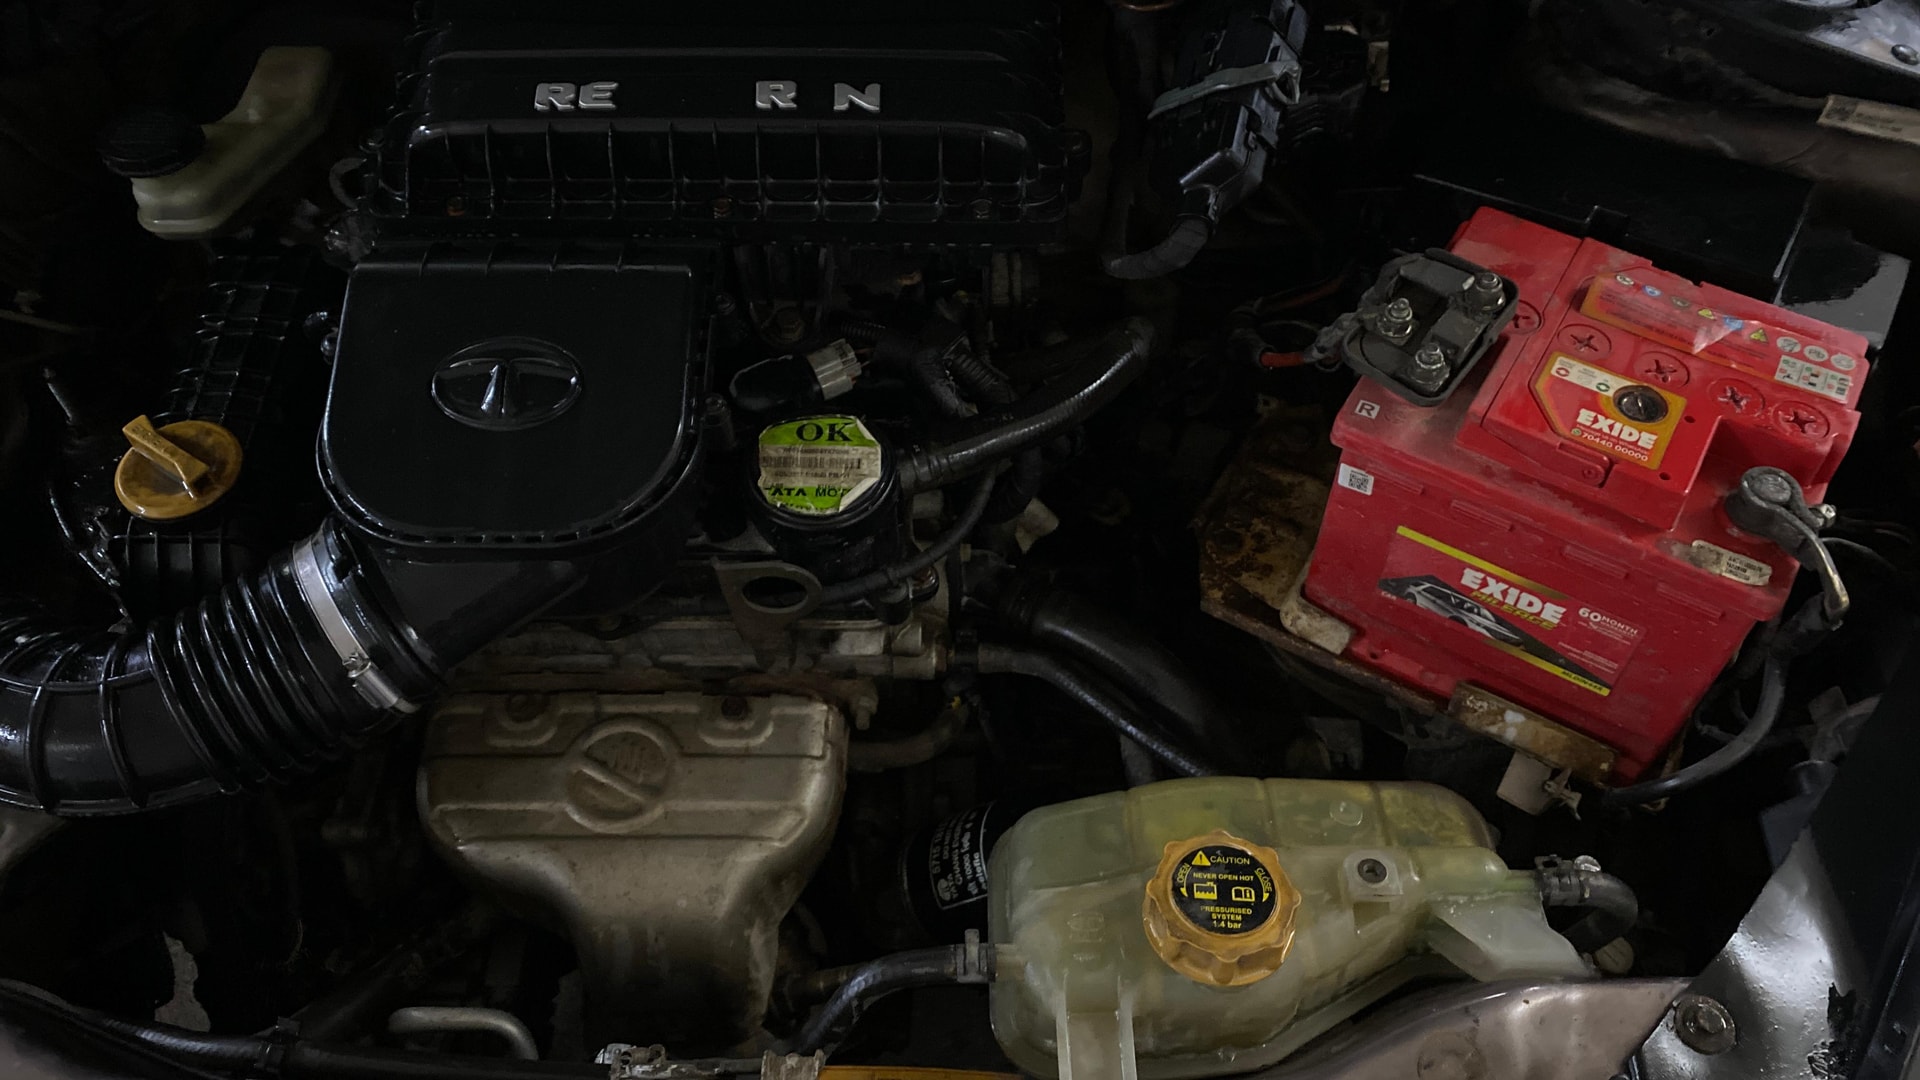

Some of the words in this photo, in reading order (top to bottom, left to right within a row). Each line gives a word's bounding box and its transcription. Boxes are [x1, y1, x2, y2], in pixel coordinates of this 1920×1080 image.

[1358, 402, 1375, 417] R
[796, 422, 855, 442] OK
[1576, 408, 1658, 450] EXIDE
[1581, 431, 1613, 448] 70440
[1614, 445, 1649, 462] 00000
[815, 486, 852, 498] MOT
[1460, 567, 1567, 626] EXIDE
[1470, 590, 1561, 631] MILEAGE
[1578, 607, 1602, 622] 60
[1601, 615, 1638, 636] MONTH
[1209, 855, 1250, 865] CAUTION
[1176, 862, 1191, 884] OPEN
[1193, 872, 1217, 880] NEVER
[1239, 874, 1254, 882] HOT
[1256, 867, 1273, 893] CLOSE
[1200, 905, 1252, 915] PRESSURISED
[1211, 913, 1242, 921] SYSTEM
[1227, 921, 1242, 929] bar
